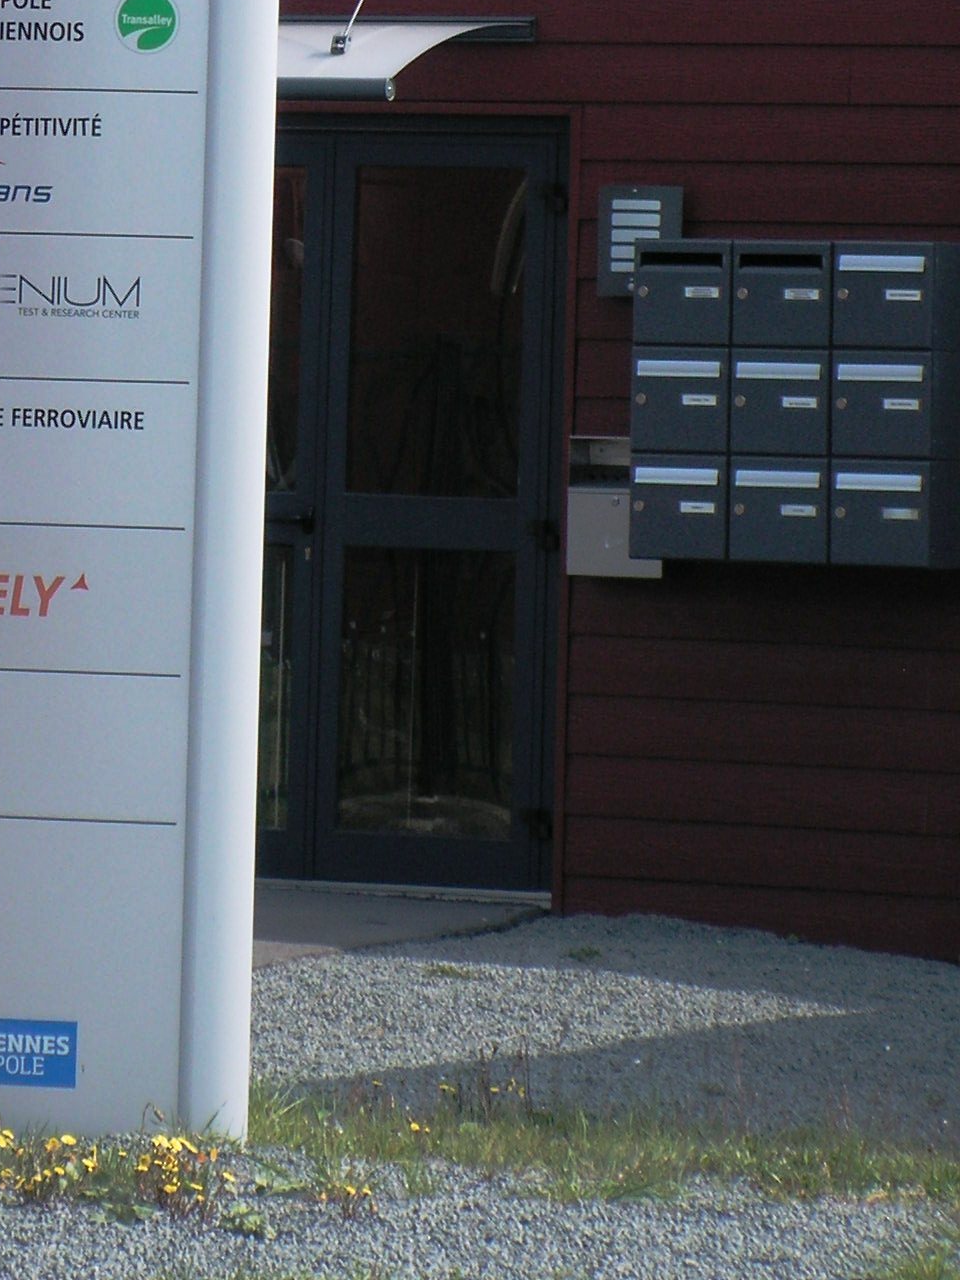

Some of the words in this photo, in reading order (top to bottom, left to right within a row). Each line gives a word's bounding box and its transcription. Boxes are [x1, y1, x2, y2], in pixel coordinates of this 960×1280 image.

[121, 14, 173, 27] Transalley
[18, 307, 40, 317] TEST
[50, 308, 100, 318] RESEARCH
[101, 309, 140, 320] CENTER
[11, 407, 144, 431] FERROVIAIRE
